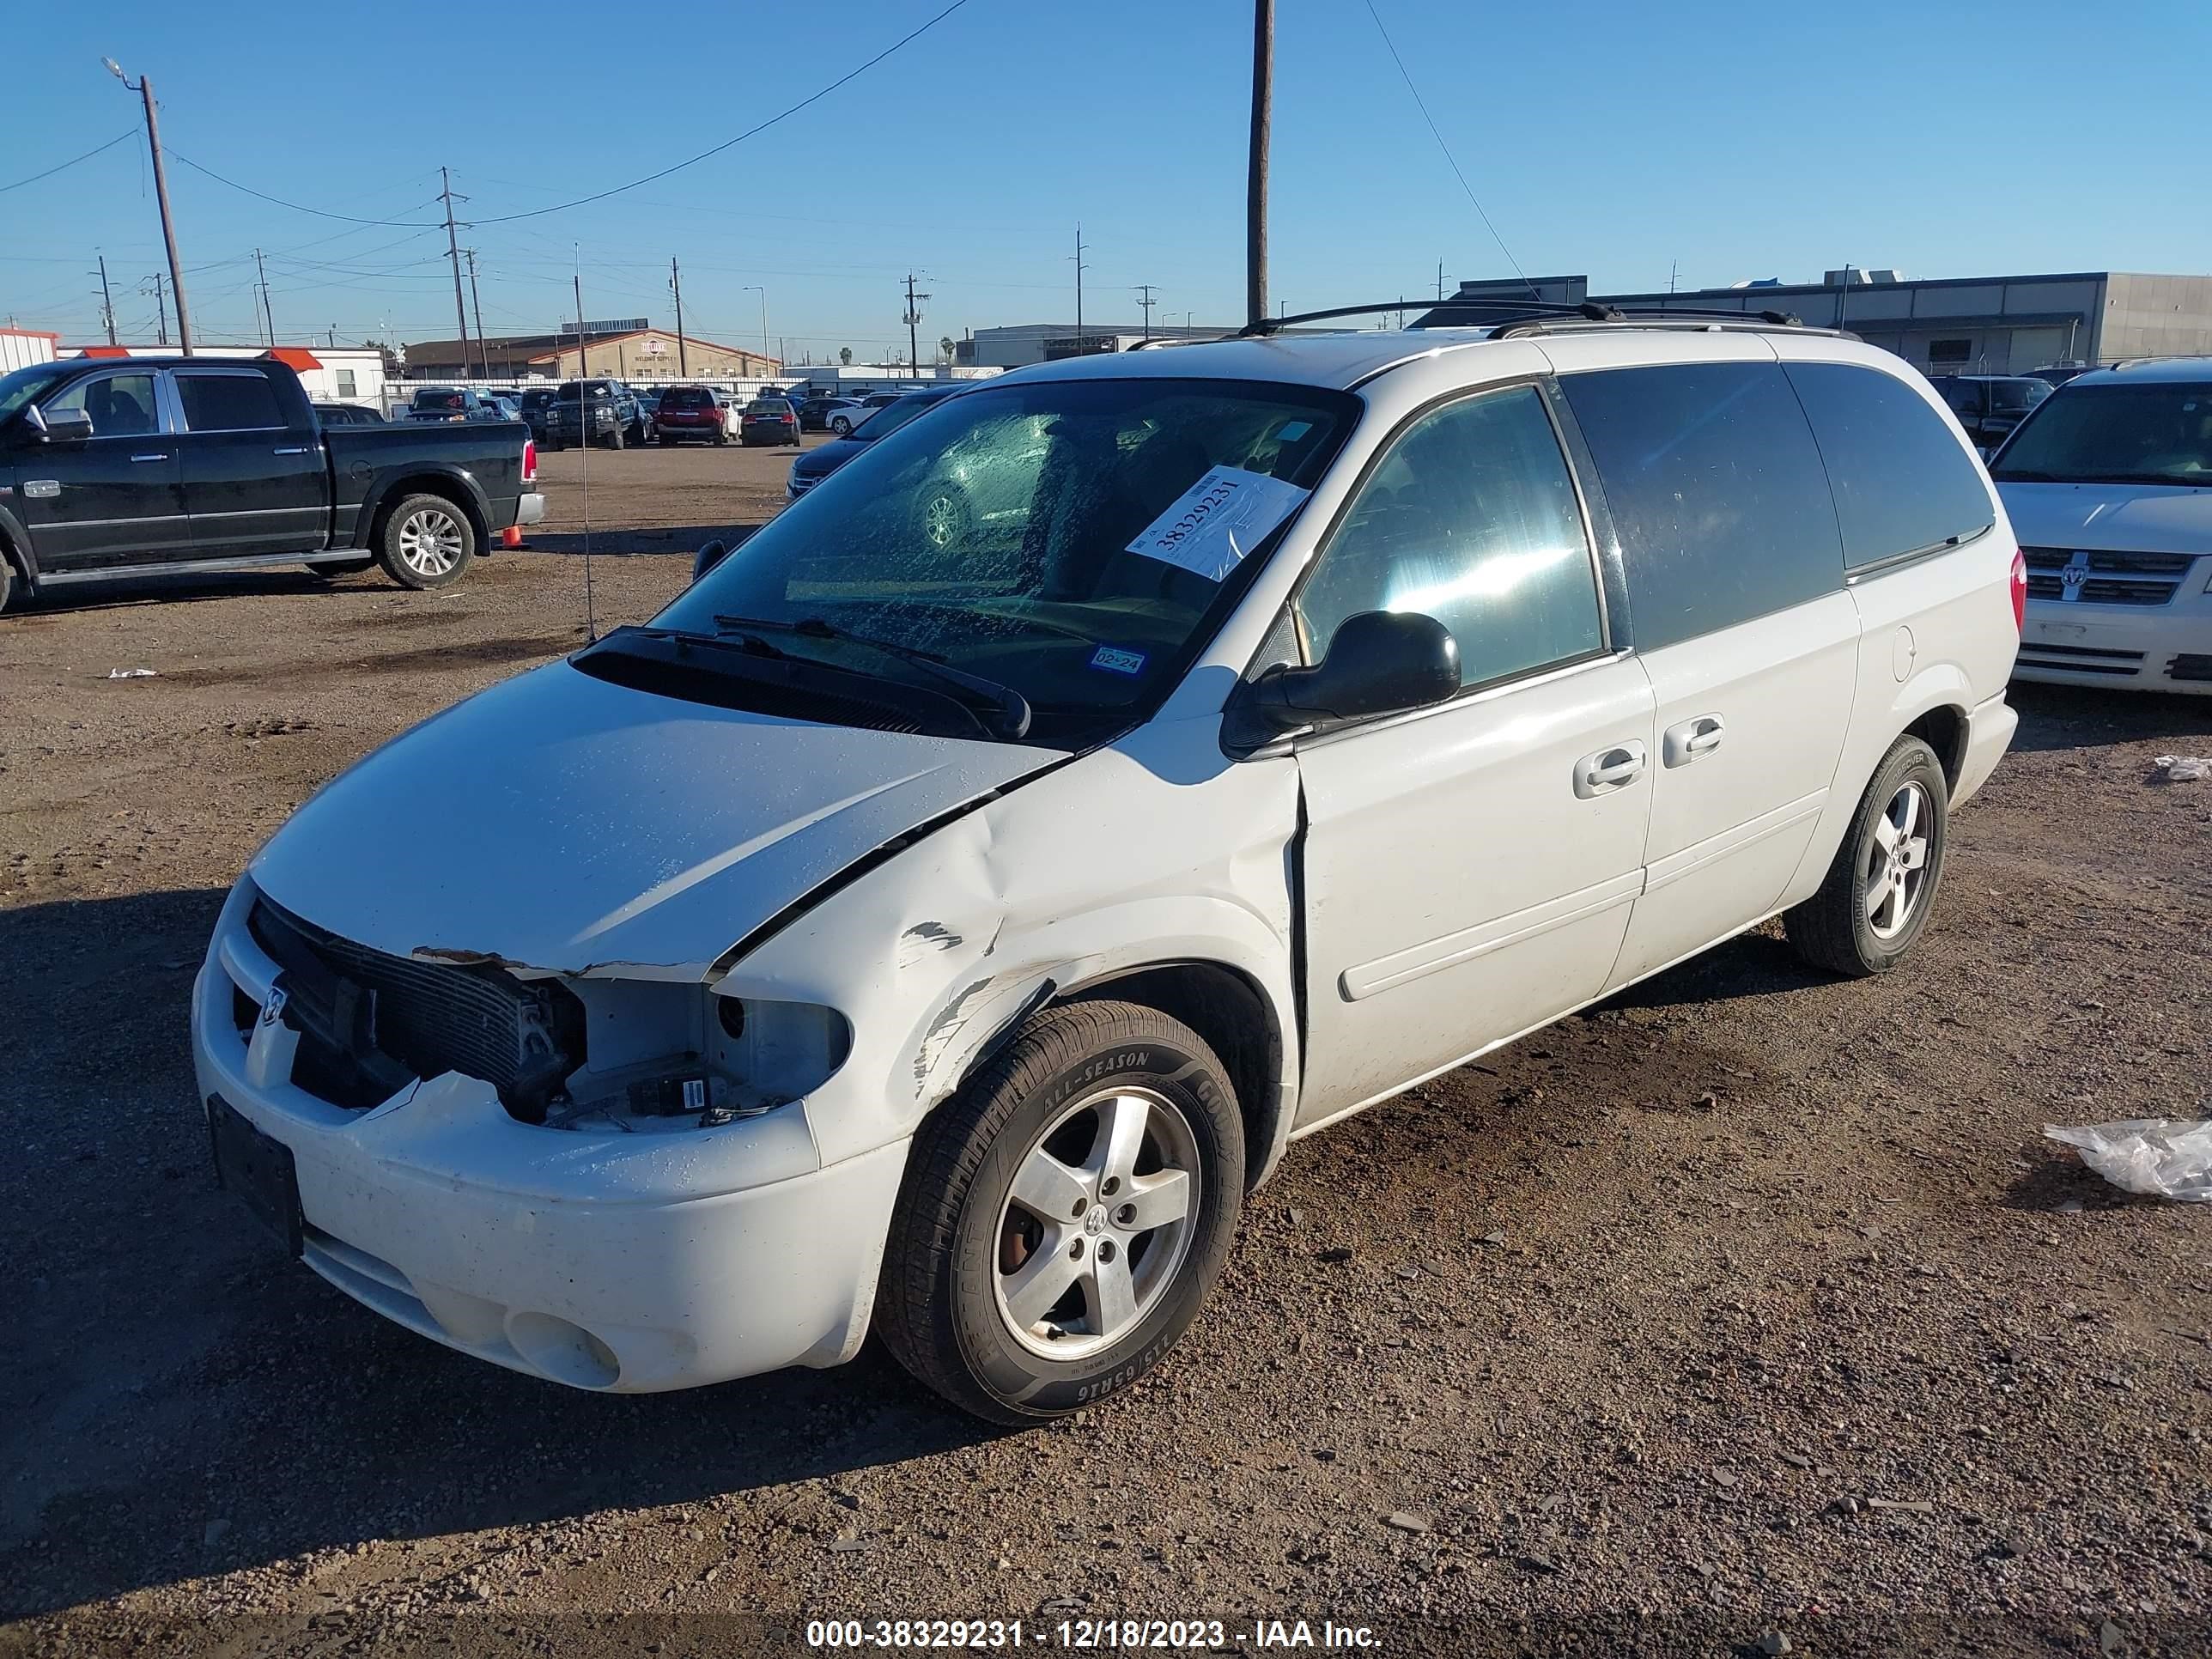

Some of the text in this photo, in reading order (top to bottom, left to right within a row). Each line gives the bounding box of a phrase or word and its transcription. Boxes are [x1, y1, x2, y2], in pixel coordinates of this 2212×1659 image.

[642, 343, 666, 351] DELUXE
[1156, 481, 1240, 551] 38329231
[1043, 1052, 1150, 1114] ALL-SEASON
[1077, 1333, 1171, 1402] 215/65R16
